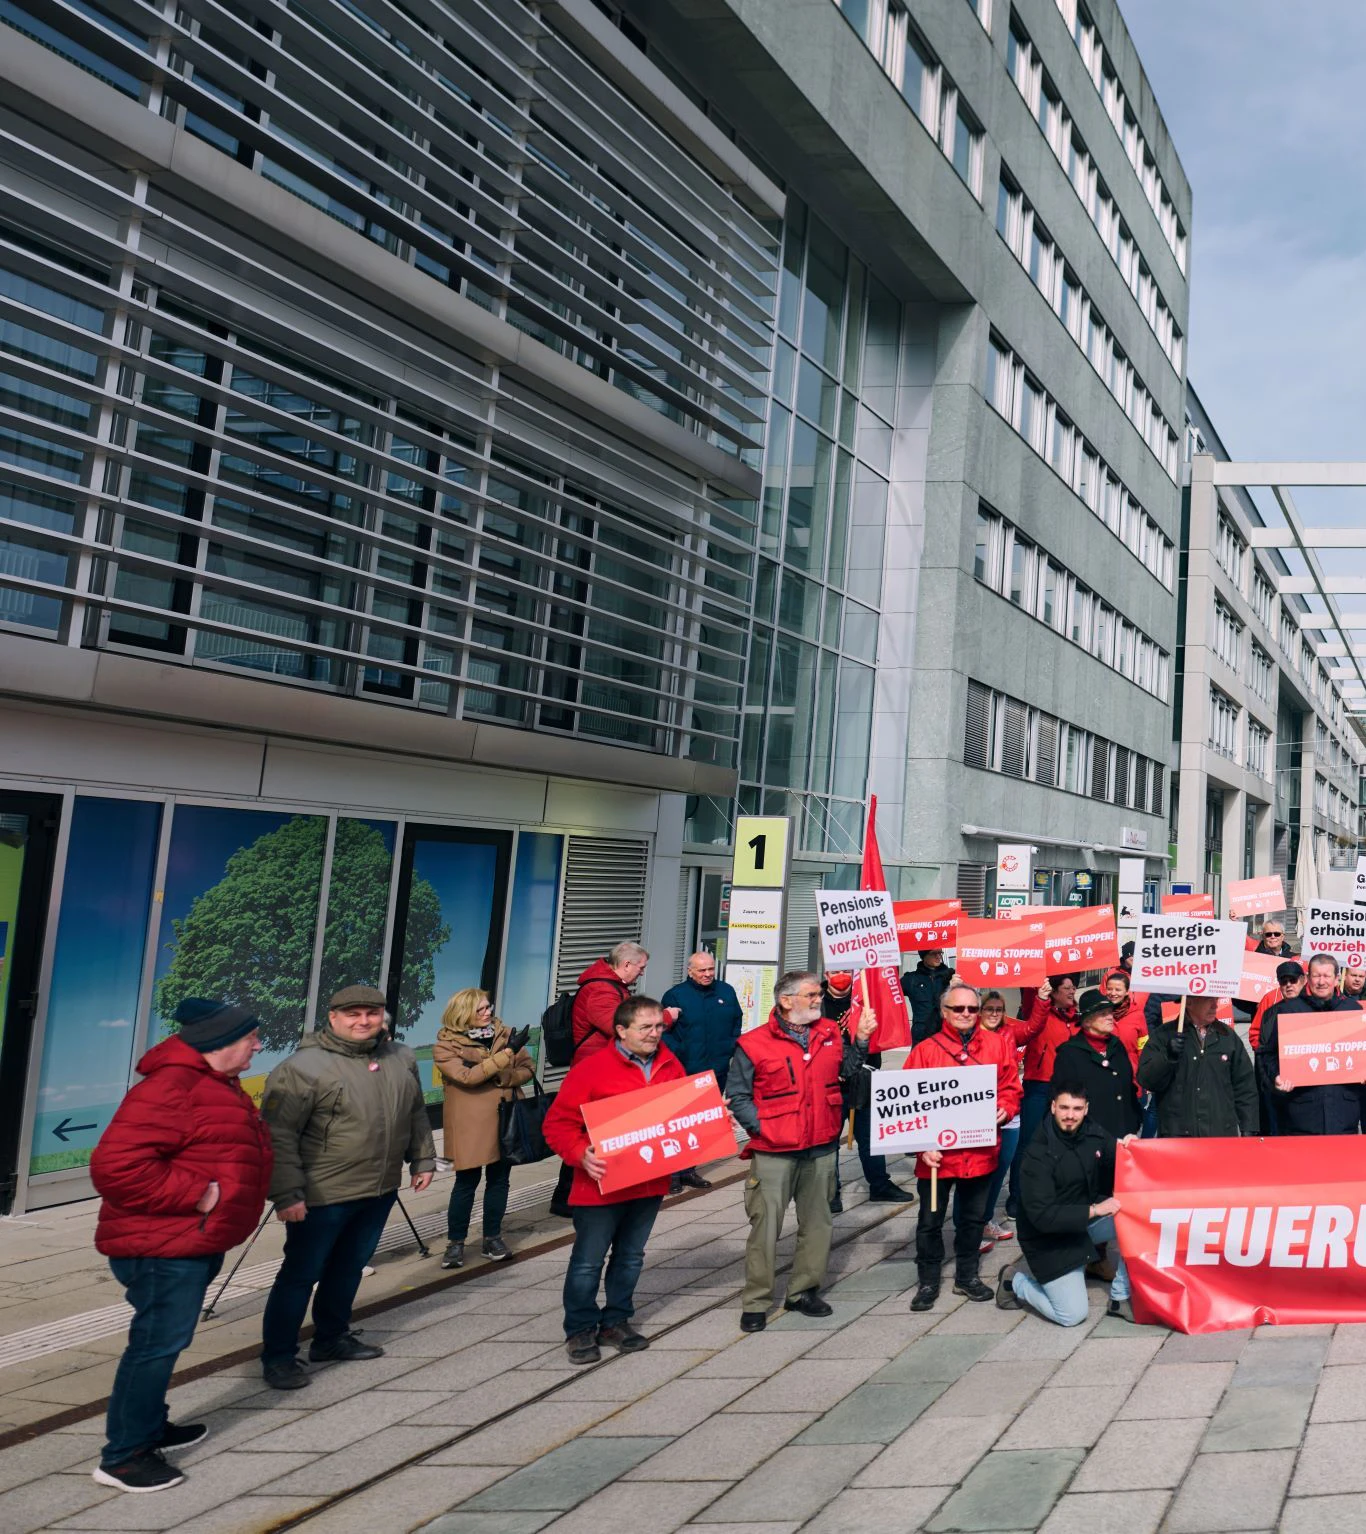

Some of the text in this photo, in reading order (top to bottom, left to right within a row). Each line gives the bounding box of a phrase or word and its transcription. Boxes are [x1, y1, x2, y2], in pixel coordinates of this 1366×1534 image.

[748, 835, 766, 869] 1
[820, 896, 884, 917] Pensions-
[825, 911, 889, 936] erhöhung
[897, 920, 932, 930] TEUERUNG
[1141, 923, 1220, 941] Energie-
[829, 928, 896, 956] vorziehen!
[1045, 931, 1114, 949] ERUNG STOPPEN!
[1141, 944, 1216, 958] steuern
[961, 948, 1044, 959] TEUERUNG STOPPEN!
[1141, 960, 1218, 977] senken!
[882, 966, 903, 1005] gend
[1283, 1042, 1332, 1055] TEUERUNG
[875, 1079, 959, 1102] 300 Euro
[877, 1089, 995, 1119] Winterbonus
[600, 1106, 724, 1152] TEUERUNG STOPPEN!
[878, 1116, 928, 1140] jetzt!
